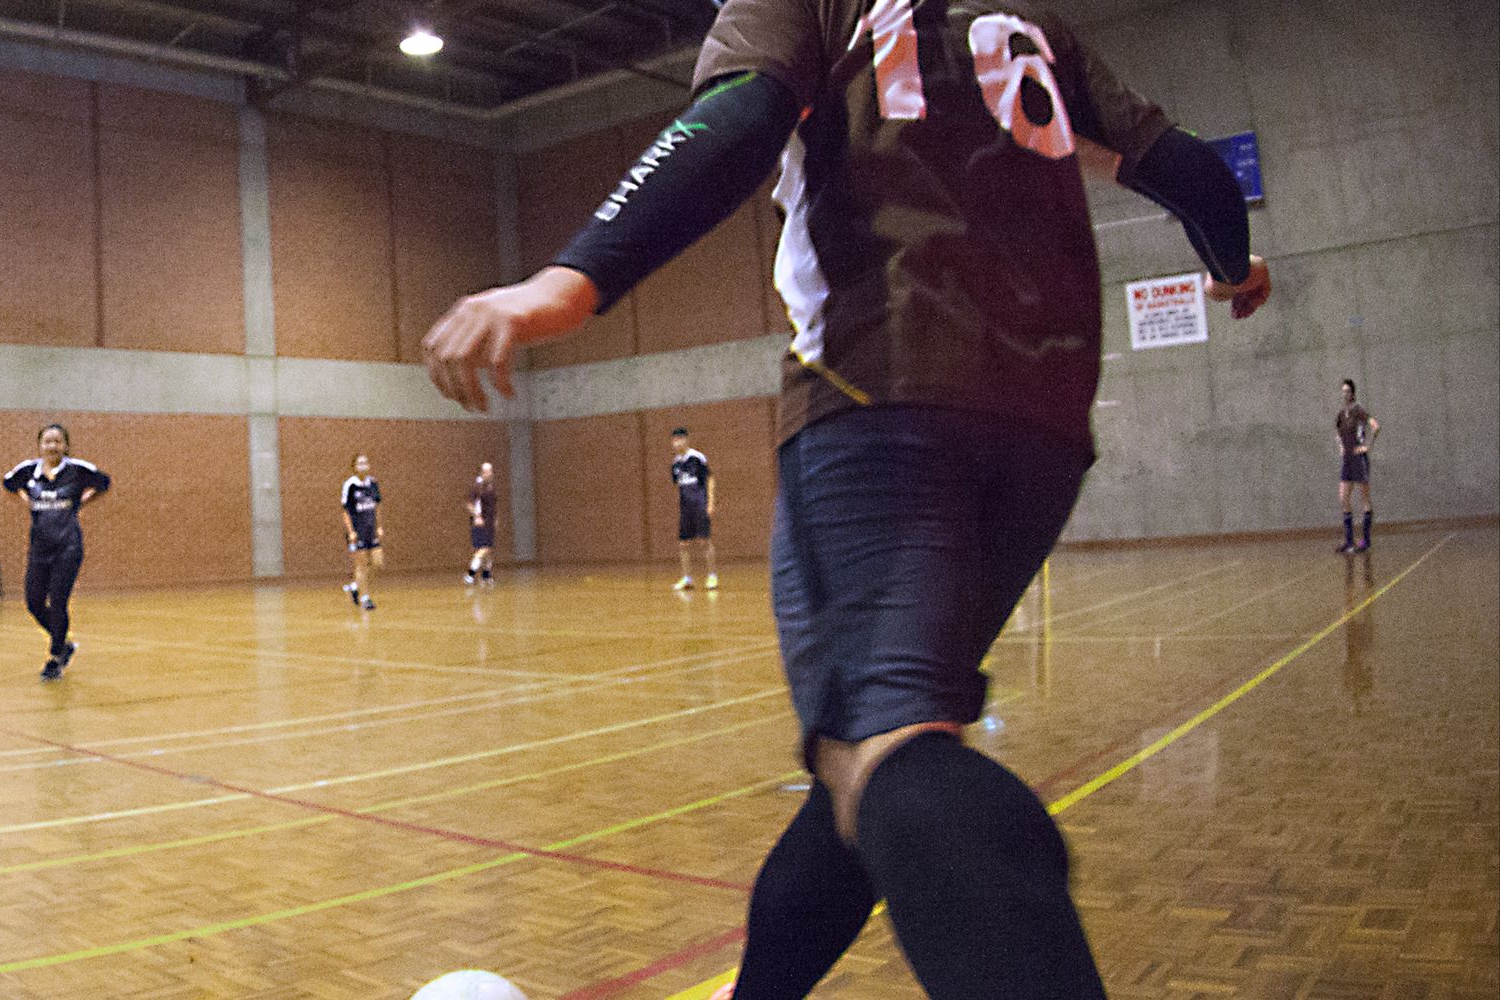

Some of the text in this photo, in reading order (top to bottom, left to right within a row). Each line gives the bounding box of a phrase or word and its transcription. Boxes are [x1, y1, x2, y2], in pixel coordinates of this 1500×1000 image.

[850, 0, 1076, 160] 16
[1133, 282, 1196, 301] NO DUNKING
